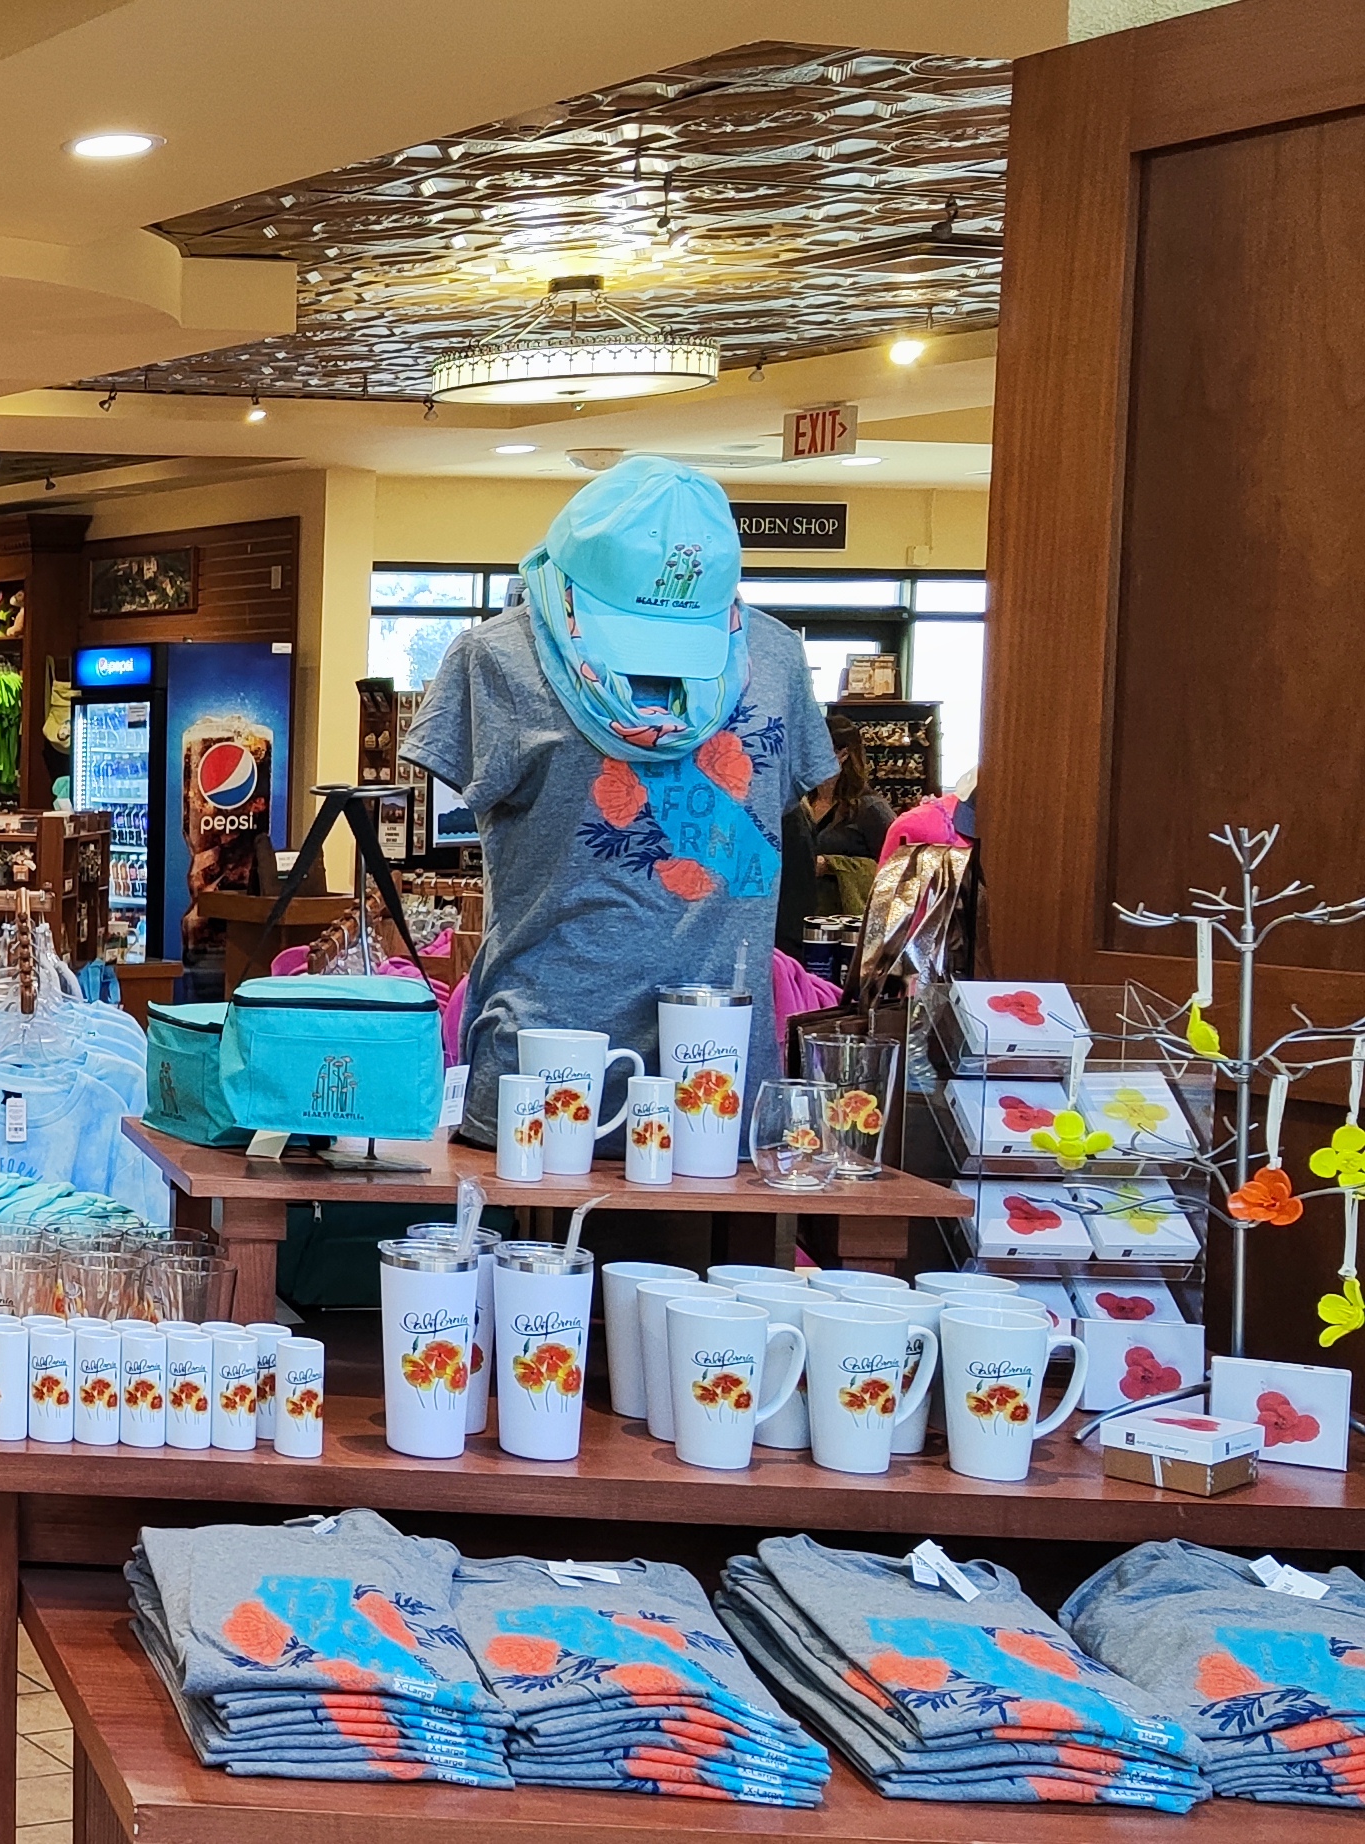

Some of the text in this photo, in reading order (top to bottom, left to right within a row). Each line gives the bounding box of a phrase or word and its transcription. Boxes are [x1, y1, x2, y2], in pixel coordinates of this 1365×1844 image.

[794, 409, 840, 456] EXIT
[739, 516, 839, 535] RDEN SHOP
[636, 597, 670, 607] HEARST
[107, 657, 135, 675] pepsi
[200, 811, 254, 834] pepsi
[671, 1040, 743, 1066] California
[538, 1066, 594, 1084] California
[399, 1308, 471, 1335] California
[510, 1311, 584, 1337] California
[31, 1354, 69, 1370] California
[80, 1357, 118, 1374] California
[124, 1359, 163, 1375] California
[691, 1349, 757, 1368] California
[838, 1355, 901, 1373] California
[169, 1360, 208, 1376] California
[965, 1360, 1034, 1379] California
[397, 1680, 432, 1699] X-Large
[429, 1734, 463, 1745] X-Large
[431, 1744, 465, 1756] X-Large
[429, 1755, 464, 1767] X-Large
[441, 1772, 476, 1785] X-Large
